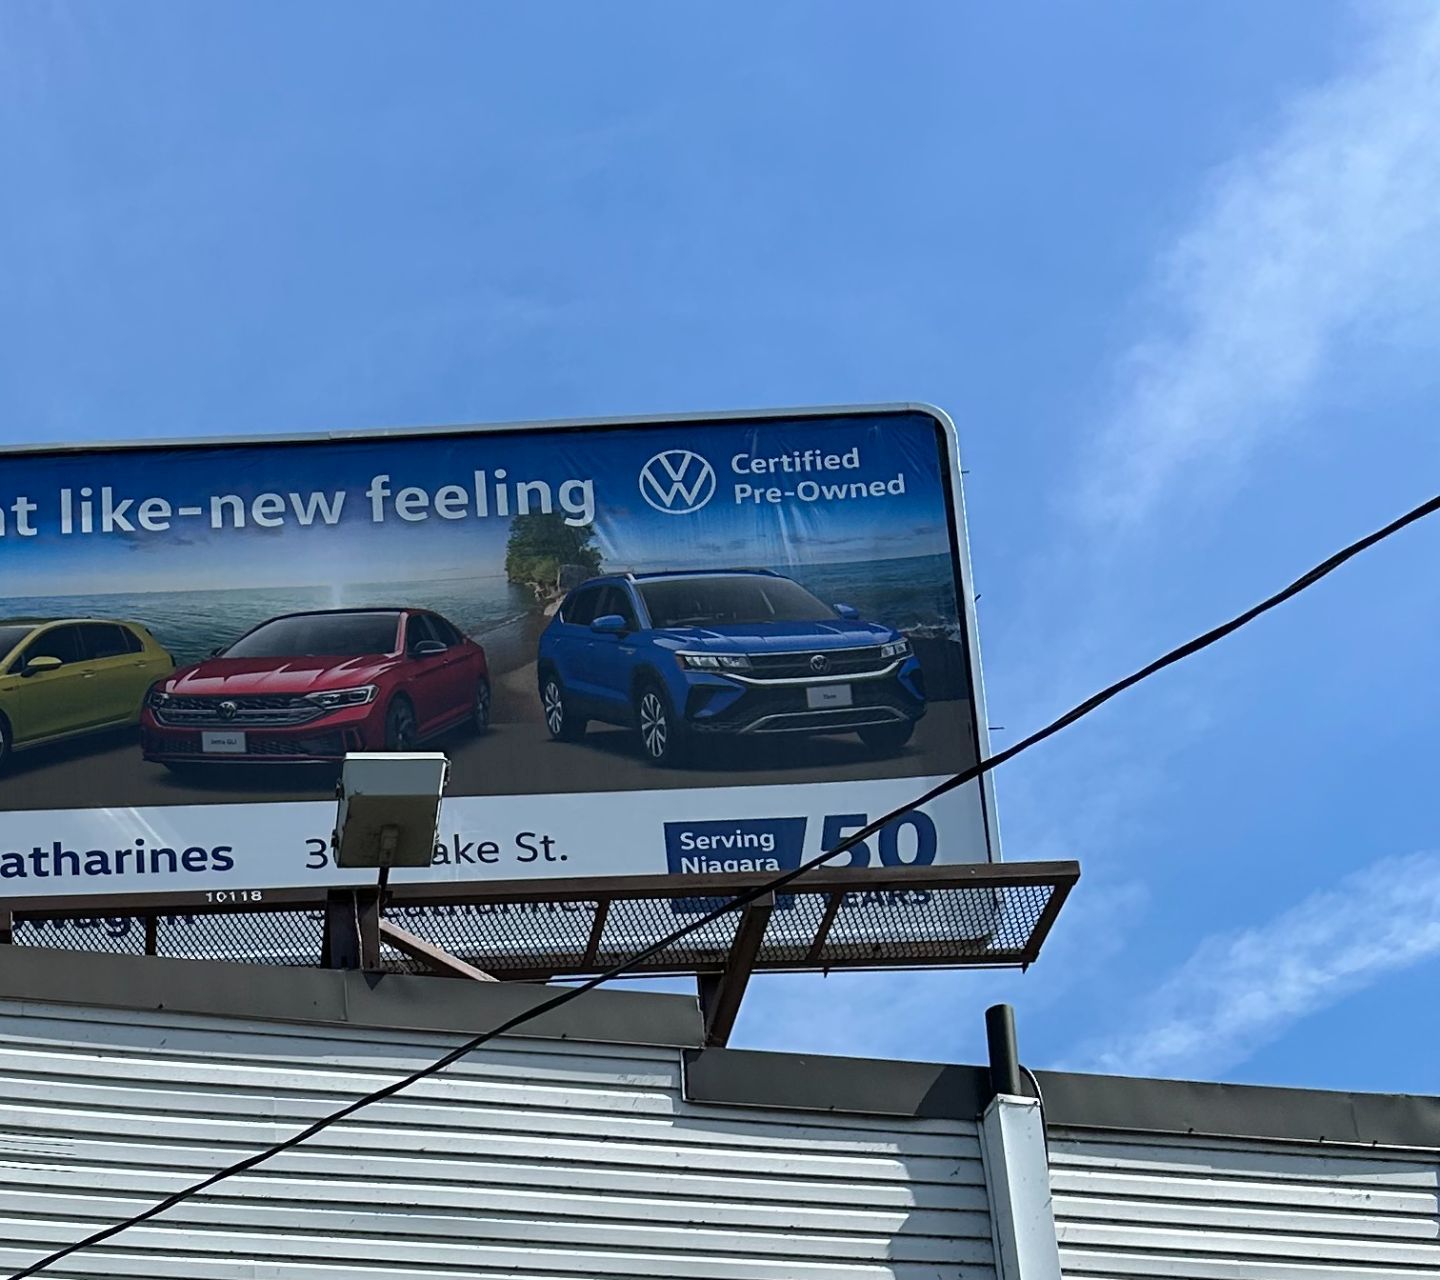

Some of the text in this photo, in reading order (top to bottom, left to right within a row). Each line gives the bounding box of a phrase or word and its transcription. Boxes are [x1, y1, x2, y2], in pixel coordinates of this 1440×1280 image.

[730, 447, 861, 475] Certified
[60, 487, 347, 535] like-new
[366, 469, 596, 528] feeling
[734, 473, 906, 505] Pre-Owned
[431, 833, 500, 865] ake
[515, 831, 568, 863] St.
[679, 829, 776, 851] Serving
[815, 809, 937, 869] 50
[680, 856, 781, 875] Niagara
[205, 890, 263, 903] 10118
